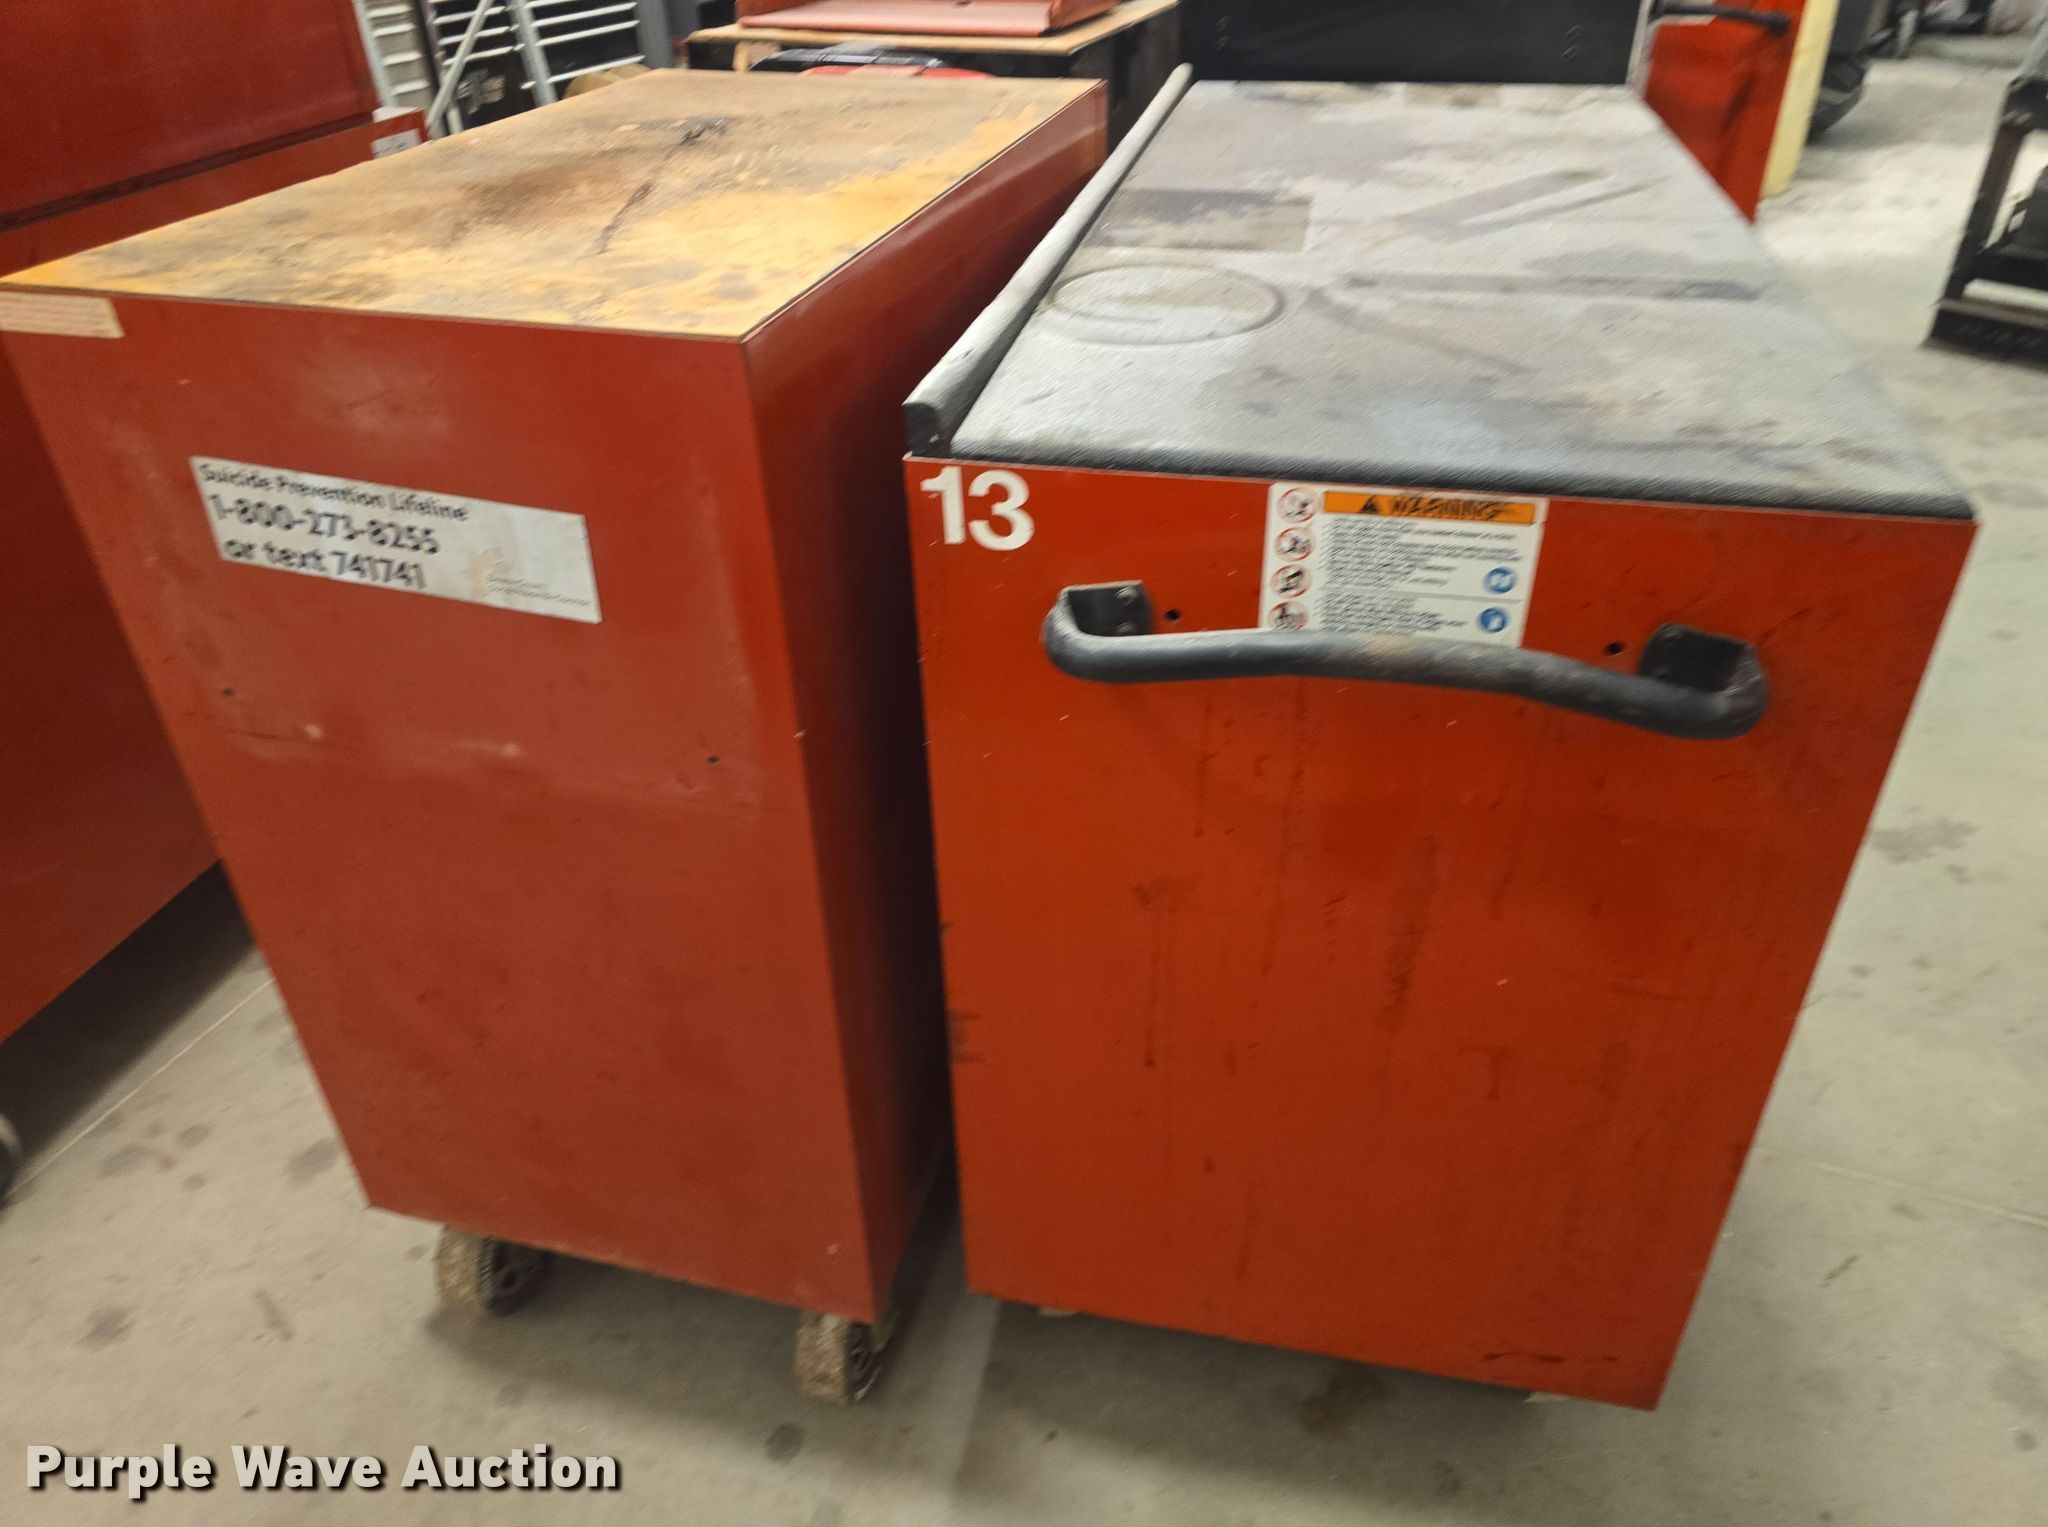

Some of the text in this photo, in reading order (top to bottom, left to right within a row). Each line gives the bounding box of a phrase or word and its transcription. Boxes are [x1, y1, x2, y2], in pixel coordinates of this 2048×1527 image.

[200, 463, 469, 521] Suicide Prevention Lifeline
[919, 466, 1034, 551] 13
[208, 494, 440, 554] 1-800-273-8255
[224, 539, 427, 589] or text 741741
